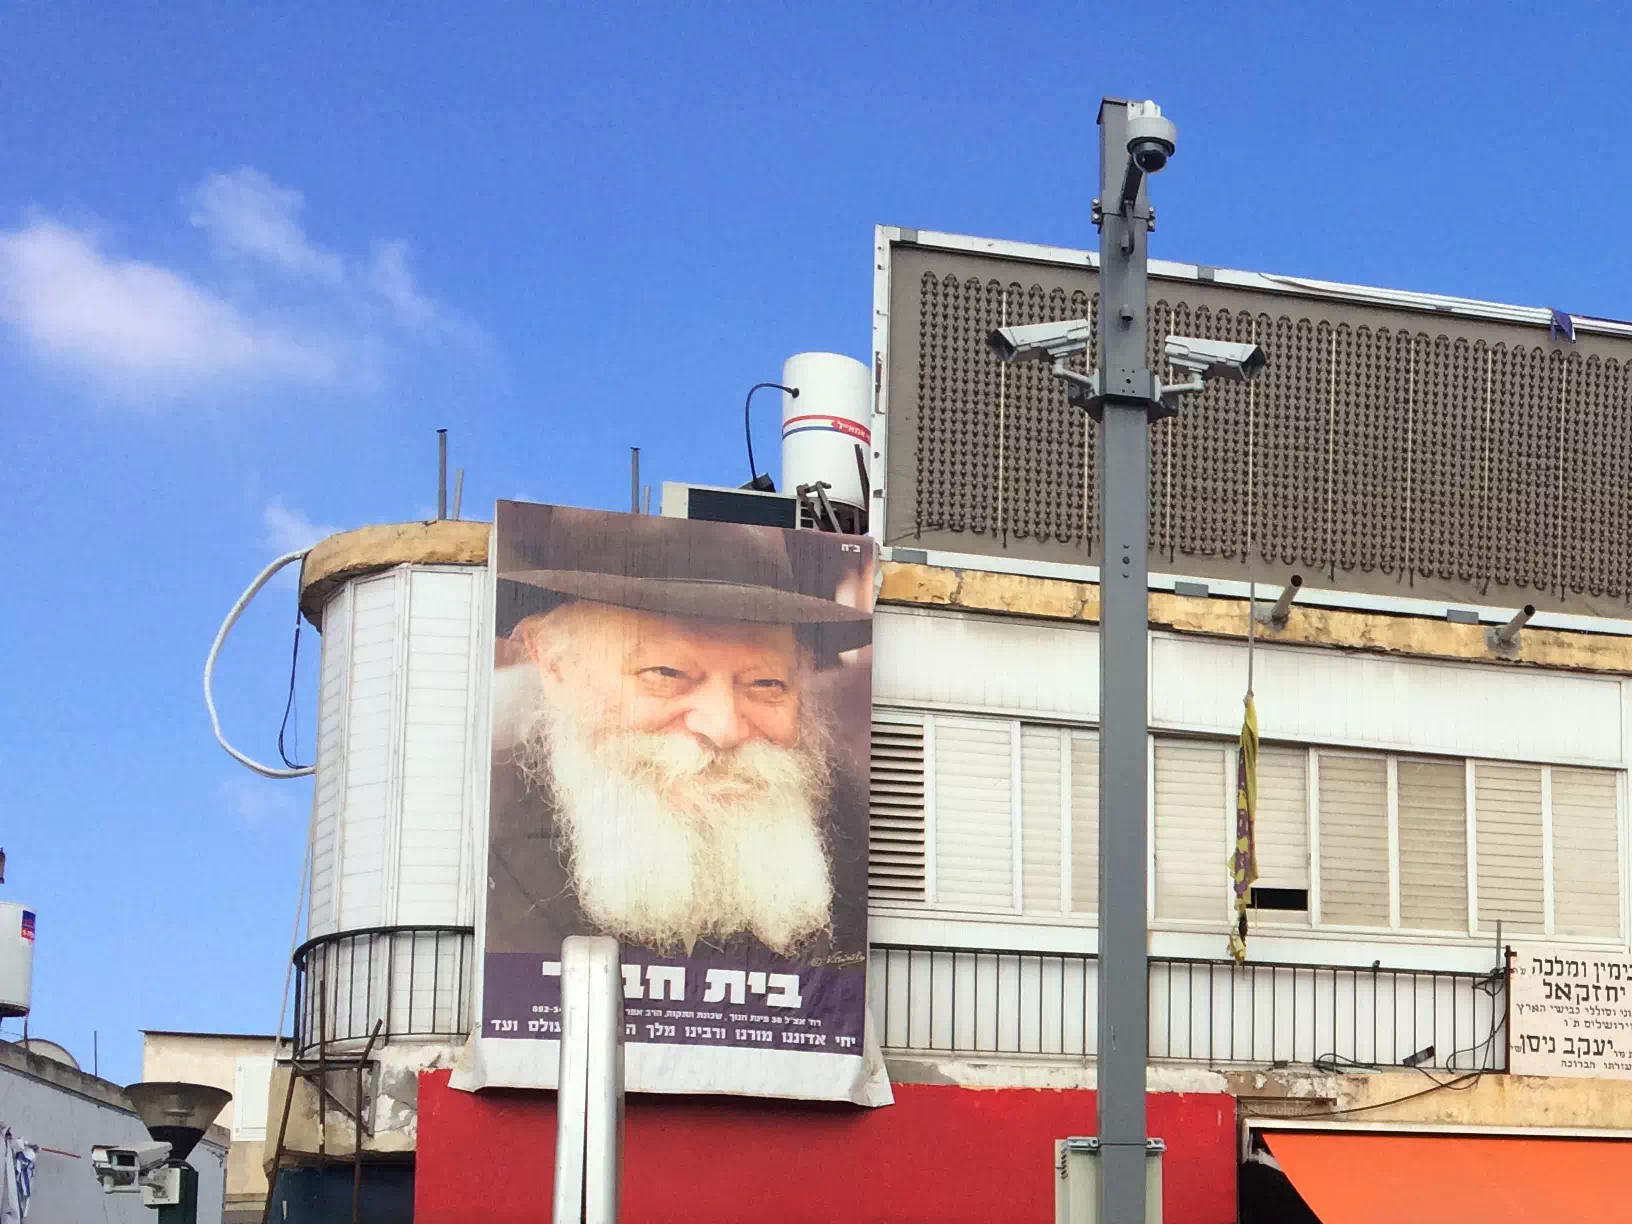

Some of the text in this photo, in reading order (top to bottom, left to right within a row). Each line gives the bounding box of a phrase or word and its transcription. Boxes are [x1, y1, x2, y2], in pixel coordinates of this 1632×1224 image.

[1532, 956, 1587, 978] ומלכה
[542, 961, 802, 1009] בית חב
[1543, 979, 1627, 1005] יחזקאל
[1516, 1003, 1547, 1016] הארץ
[490, 1019, 518, 1032] ועד
[645, 1021, 676, 1039] מלך
[685, 1025, 727, 1040] ורבינו
[735, 1029, 774, 1043] מורנו
[781, 1032, 827, 1047] אדוננו
[835, 1035, 856, 1048] יחי
[1520, 1034, 1556, 1055] ניסן
[1563, 1037, 1614, 1059] יעקב
